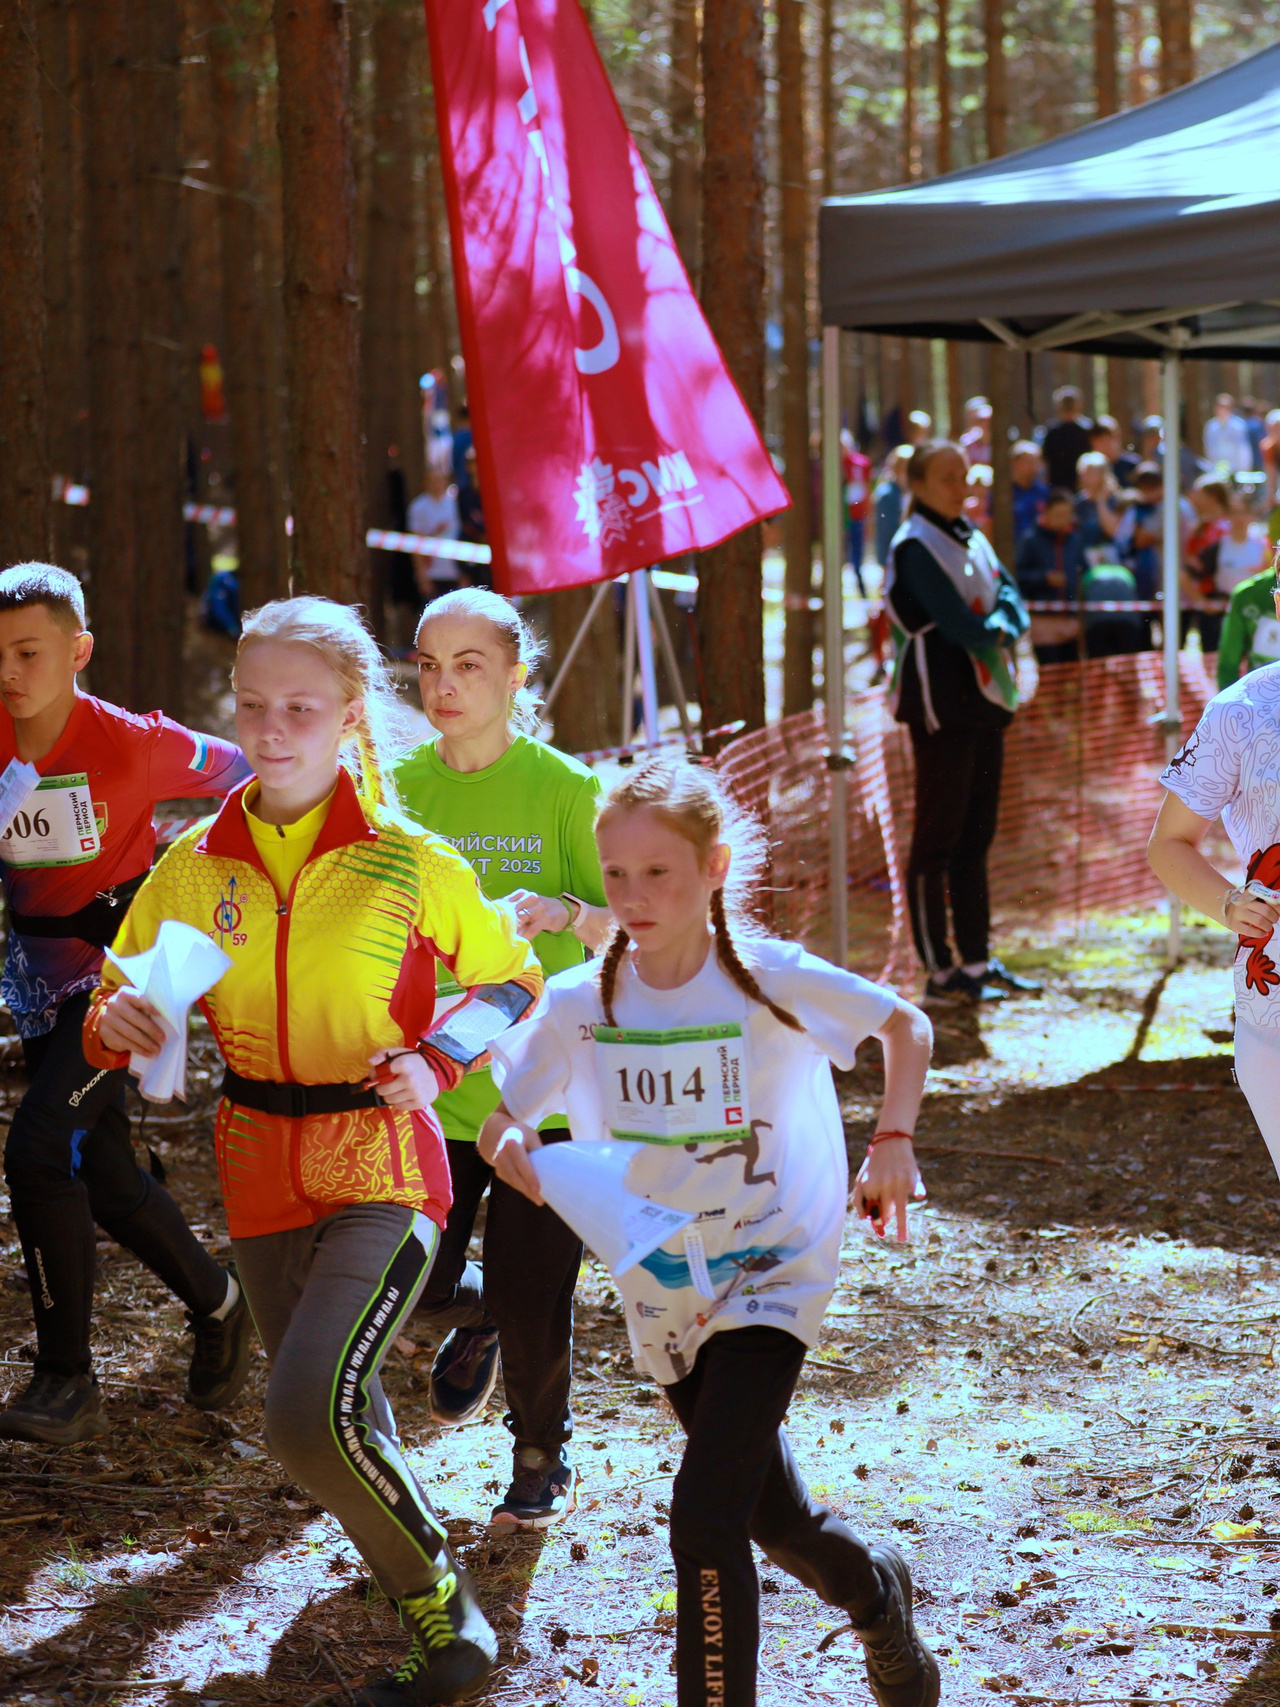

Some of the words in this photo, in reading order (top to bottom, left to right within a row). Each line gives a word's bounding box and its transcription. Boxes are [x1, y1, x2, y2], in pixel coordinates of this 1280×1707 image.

[69, 792, 84, 836] ПЕРМСКИЙ
[80, 801, 92, 835] ПЕРИОД
[500, 858, 541, 873] 2025
[233, 933, 247, 946] 59
[717, 1045, 731, 1103] ПЕРМСКИЙ
[731, 1058, 742, 1101] ПЕРИОД
[616, 1066, 705, 1106] 1014
[387, 1286, 399, 1301] FU
[365, 1326, 378, 1341] FU
[358, 1339, 372, 1354] YU
[345, 1368, 358, 1382] FU
[343, 1383, 356, 1396] YU
[340, 1396, 355, 1413] KAI
[700, 1568, 723, 1648] ENJOY
[705, 1654, 725, 1707] LIFE
